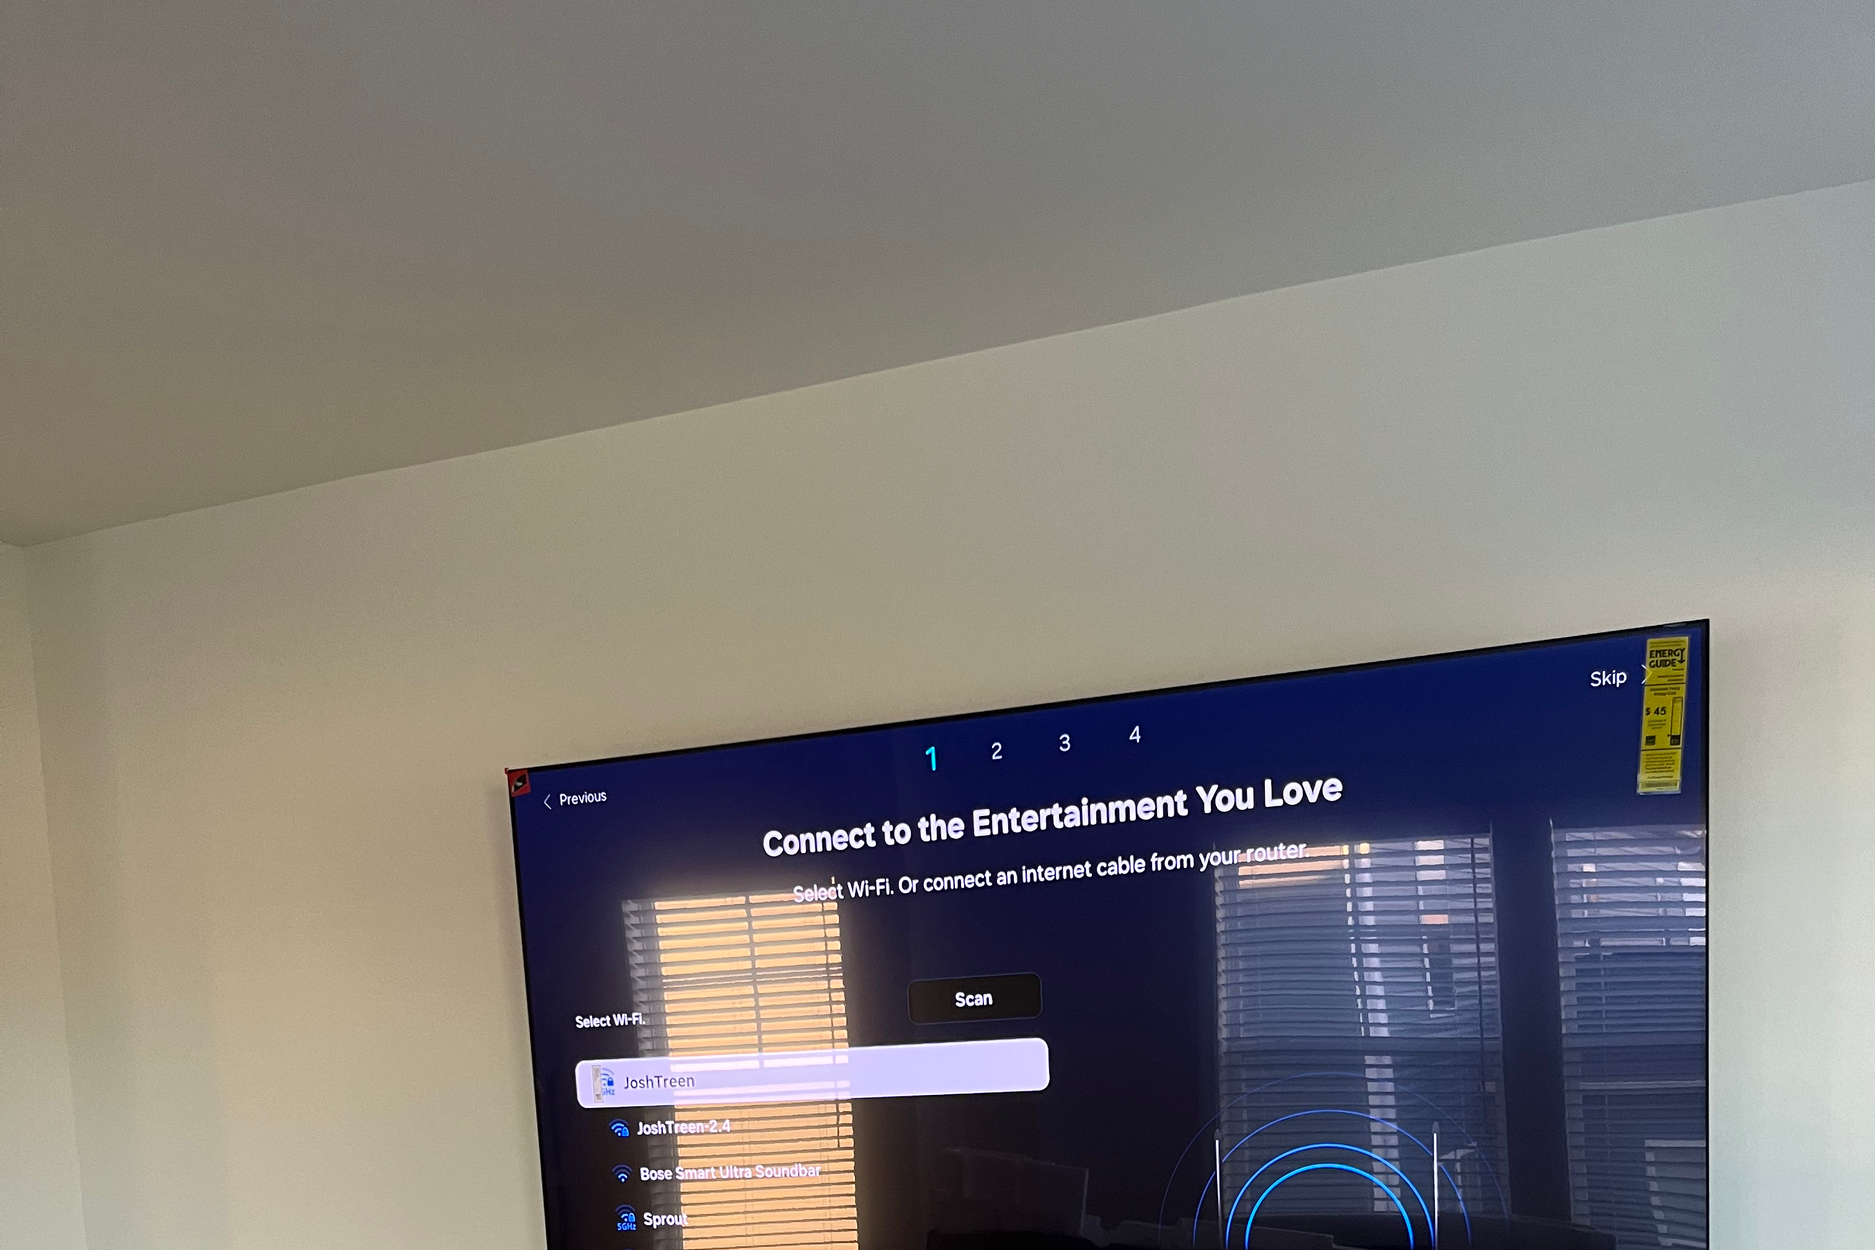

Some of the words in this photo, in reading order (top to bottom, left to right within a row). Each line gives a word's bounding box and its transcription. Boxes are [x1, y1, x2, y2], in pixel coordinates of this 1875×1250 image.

[1649, 648, 1686, 663] ENERGY
[1649, 659, 1677, 668] GUIDE
[1590, 670, 1628, 688] Skip
[1645, 707, 1651, 716] $
[1653, 707, 1667, 715] 45
[1129, 725, 1142, 743] 4
[991, 742, 1003, 760] 2
[1059, 734, 1071, 752] 3
[925, 746, 937, 772] 1
[559, 791, 608, 806] Previous
[763, 823, 877, 857] Connect
[882, 820, 912, 846] to
[918, 813, 965, 842] the
[973, 789, 1189, 837] Entertainment
[1196, 784, 1255, 814] You
[1264, 777, 1343, 808] Love
[793, 884, 844, 903] Select
[847, 878, 895, 899] Wi-Fi.
[899, 876, 919, 894] Or
[923, 869, 992, 892] connect
[996, 870, 1018, 886] an
[1022, 860, 1093, 883] internet
[1096, 856, 1146, 877] cable
[1150, 852, 1195, 872] from
[1199, 848, 1242, 872] your
[1246, 842, 1311, 863] router.
[955, 991, 994, 1008] Scan
[575, 1015, 612, 1029] Select
[612, 1012, 646, 1026] Wi-Fi.
[624, 1075, 695, 1090] JoshTreen
[637, 1119, 731, 1136] JoshTreen-2.4
[640, 1166, 673, 1181] Bose
[675, 1166, 717, 1180] Smart
[719, 1164, 752, 1179] Ultra
[755, 1163, 822, 1178] Soundbar
[617, 1222, 637, 1231] 5GHz
[643, 1212, 688, 1229] Sprout
